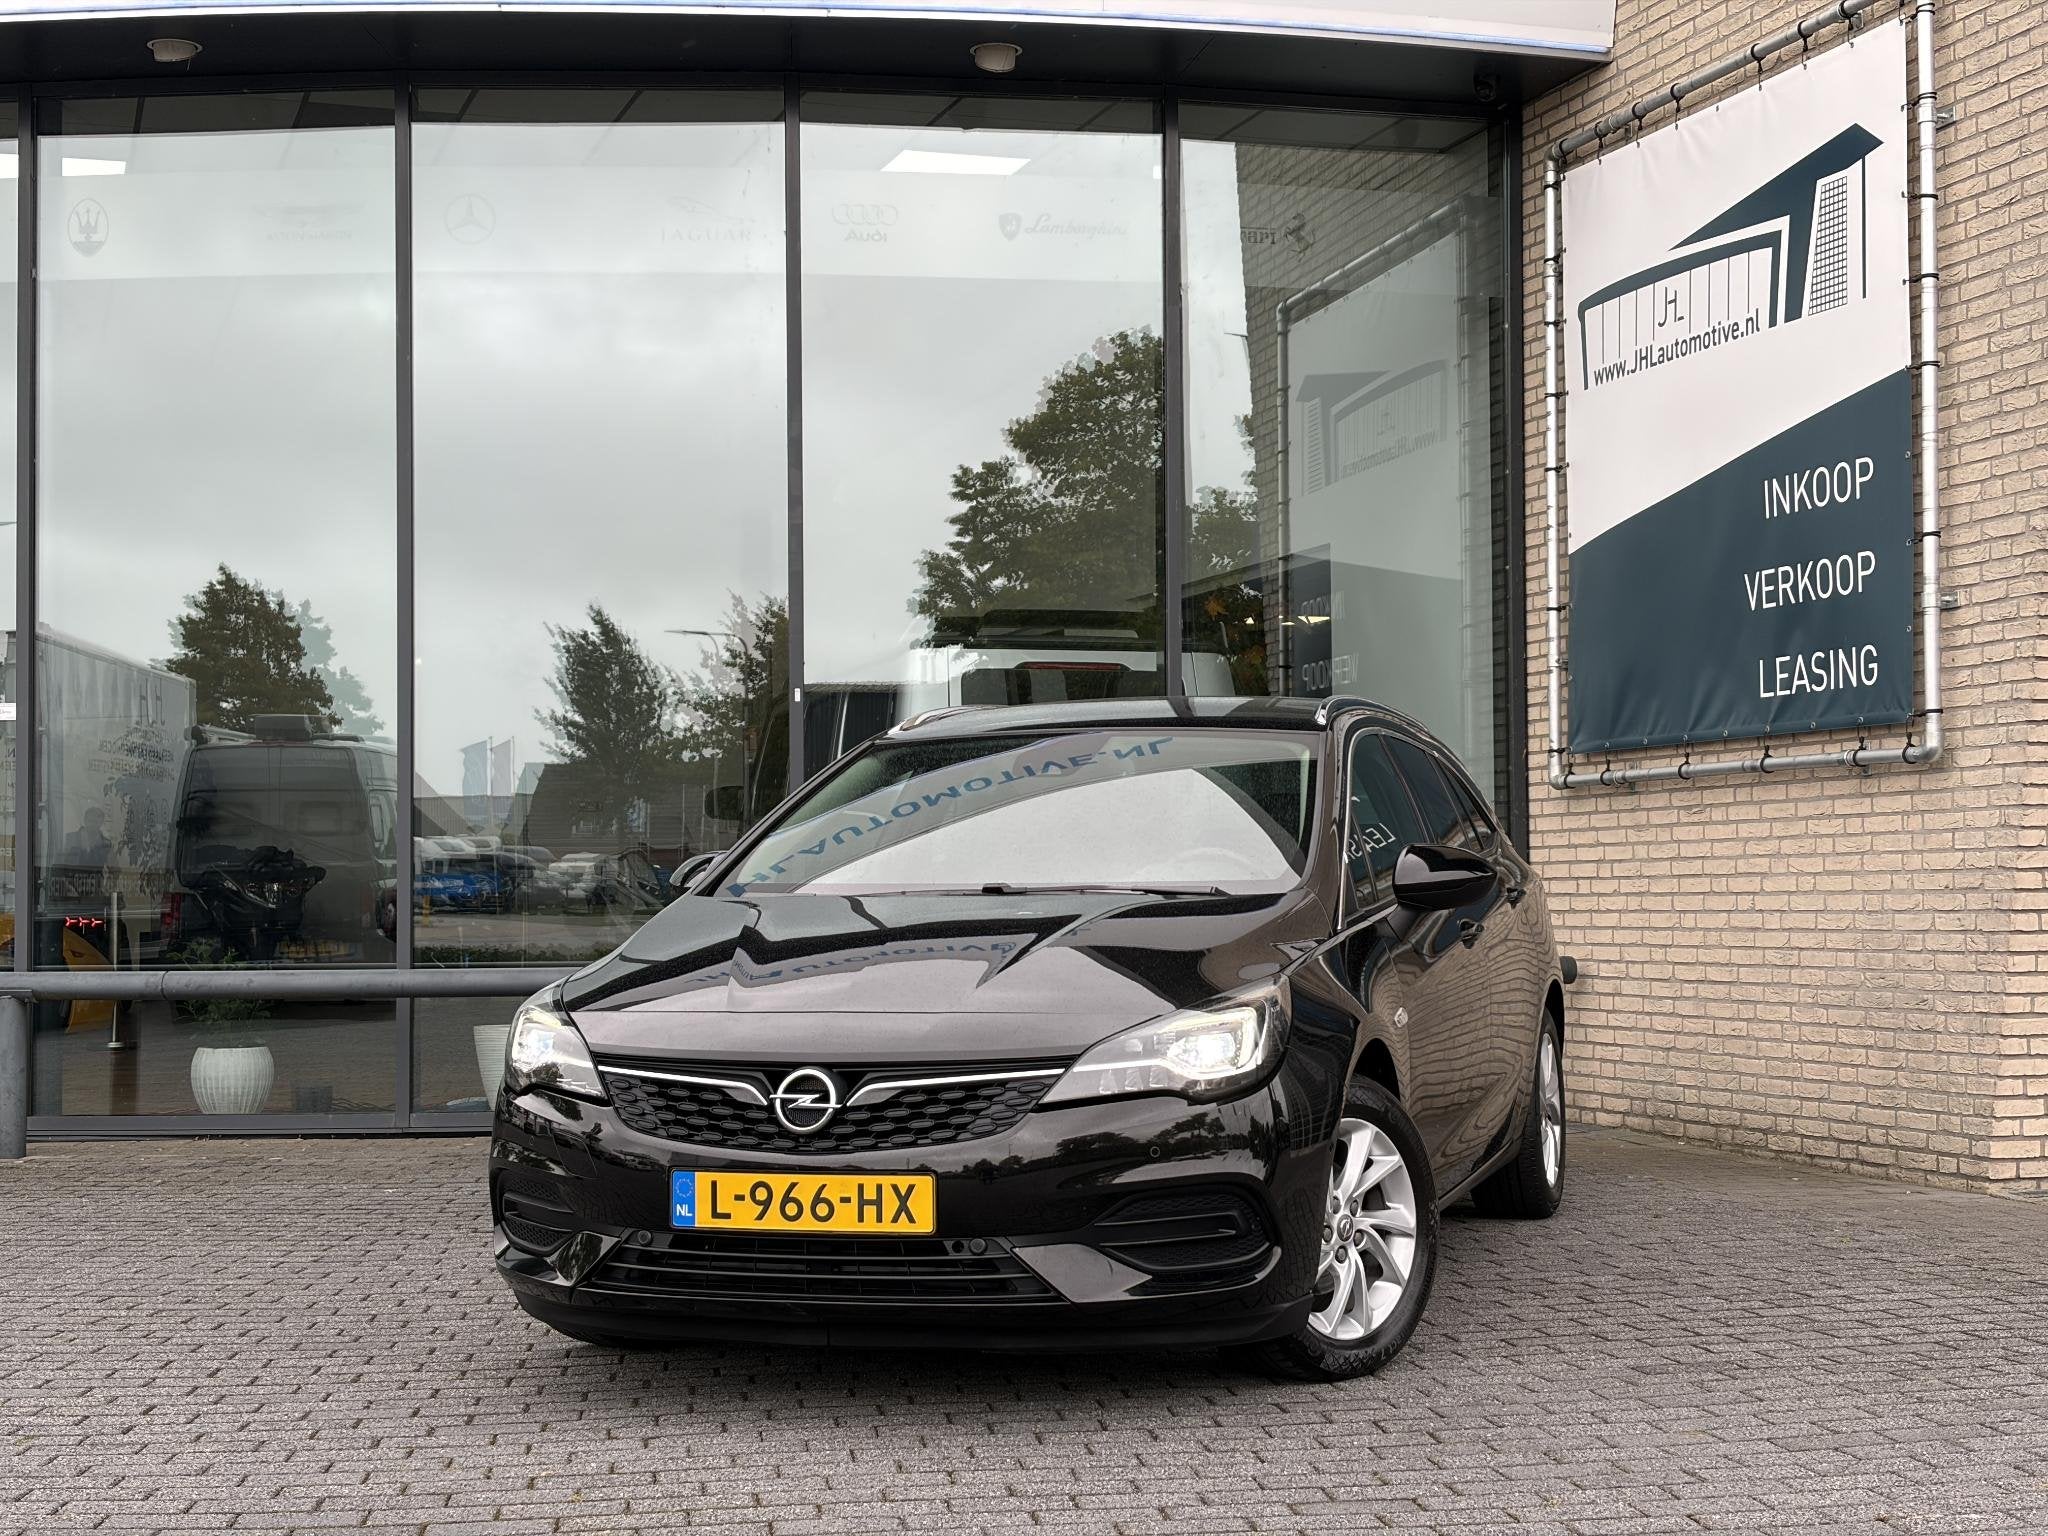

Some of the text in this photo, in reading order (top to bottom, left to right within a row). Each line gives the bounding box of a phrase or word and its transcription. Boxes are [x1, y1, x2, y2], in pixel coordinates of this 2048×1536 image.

[1593, 308, 1761, 387] www.JHLautomotive.nl
[1764, 456, 1874, 519] INKOOP
[1743, 550, 1876, 611] VERKOOP
[1759, 644, 1879, 698] LEASING
[676, 1203, 693, 1217] NL
[710, 1179, 917, 1224] L-966-HX
